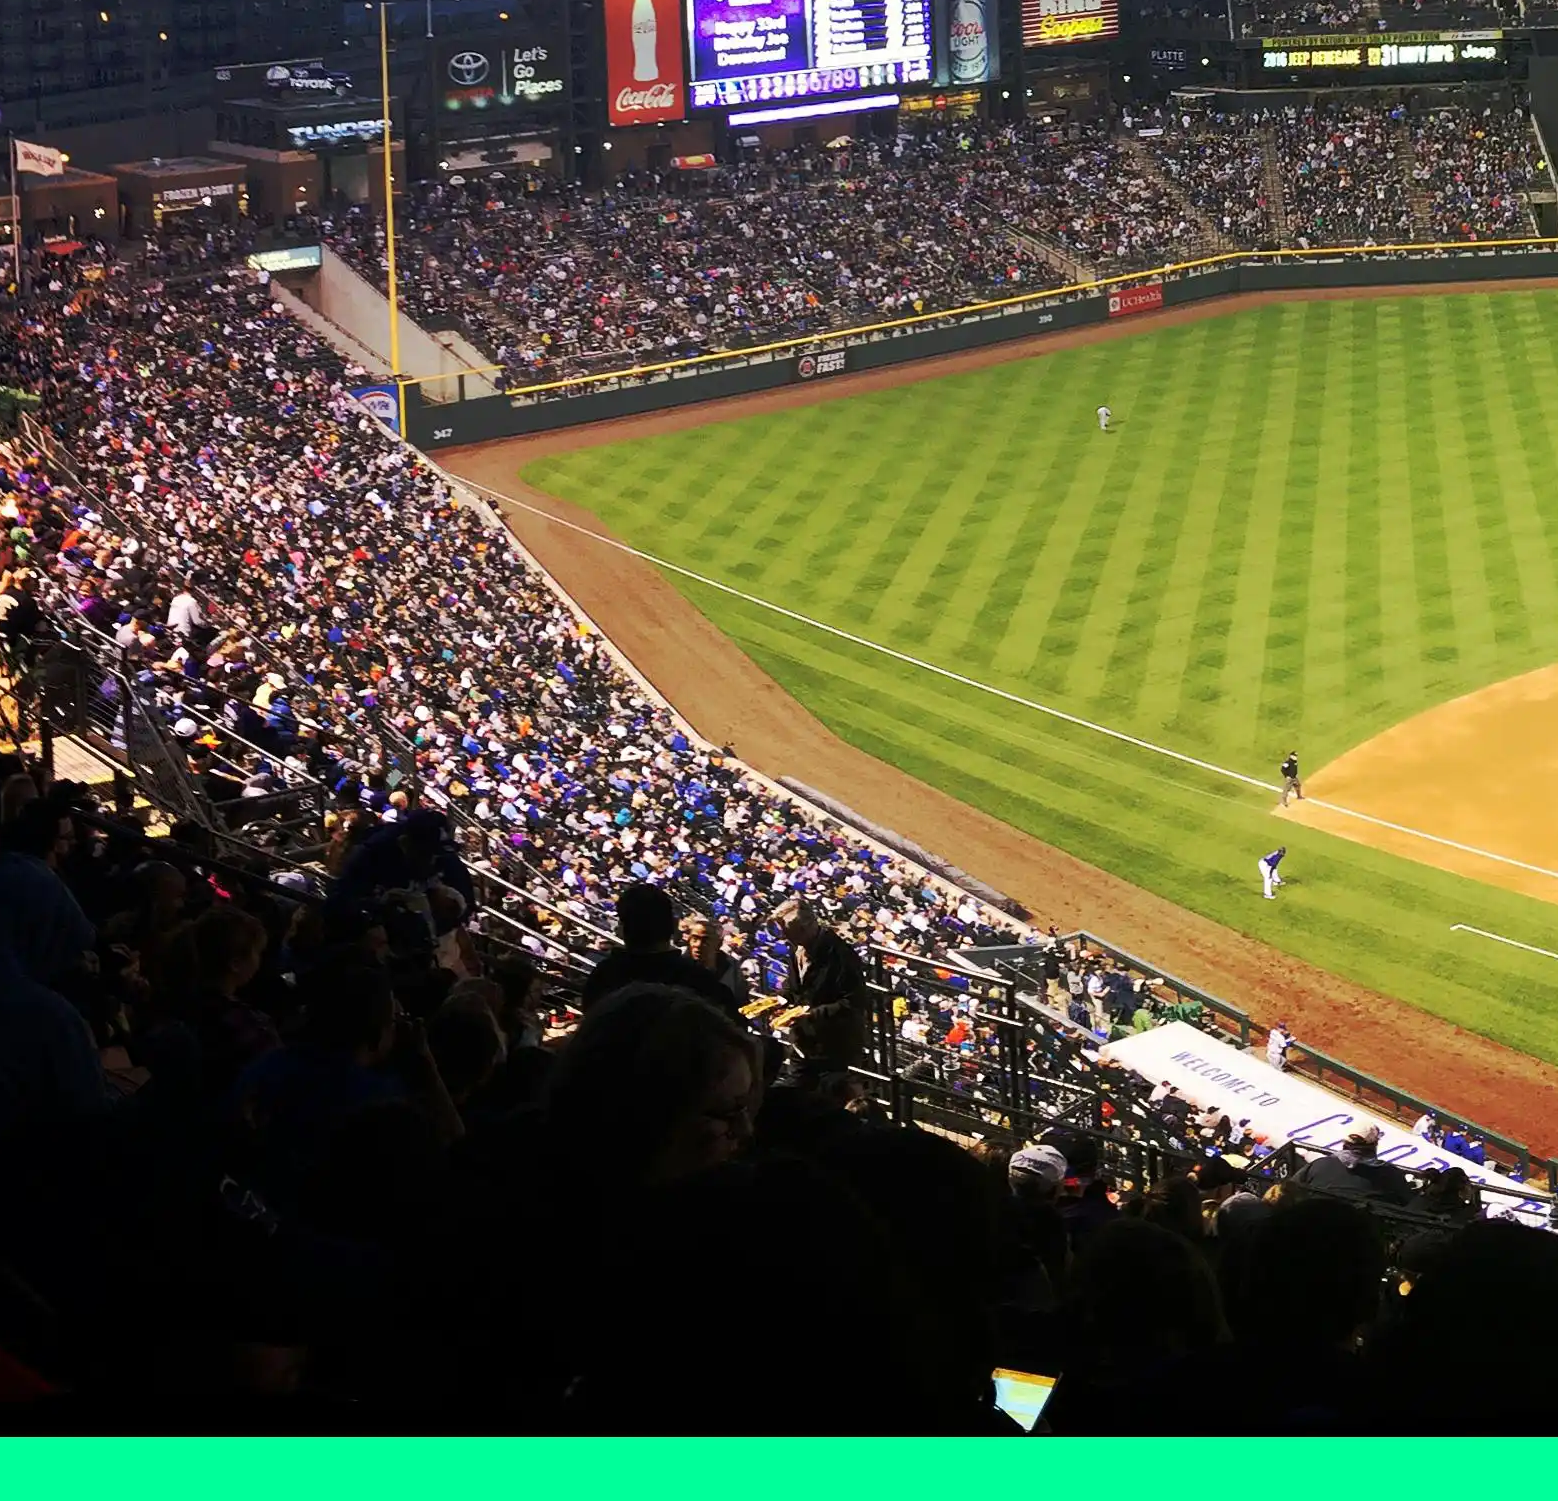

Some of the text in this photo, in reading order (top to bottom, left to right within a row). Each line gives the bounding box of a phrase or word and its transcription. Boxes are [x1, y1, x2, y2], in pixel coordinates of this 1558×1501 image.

[953, 34, 980, 47] LIGHT
[514, 47, 548, 62] Let's
[1152, 50, 1184, 61] PLATTE
[514, 64, 534, 78] Go
[290, 78, 334, 90] TOYOTA
[514, 79, 563, 95] Places
[1122, 290, 1162, 307] UCHealth
[1170, 1050, 1281, 1107] WELCOME TO
